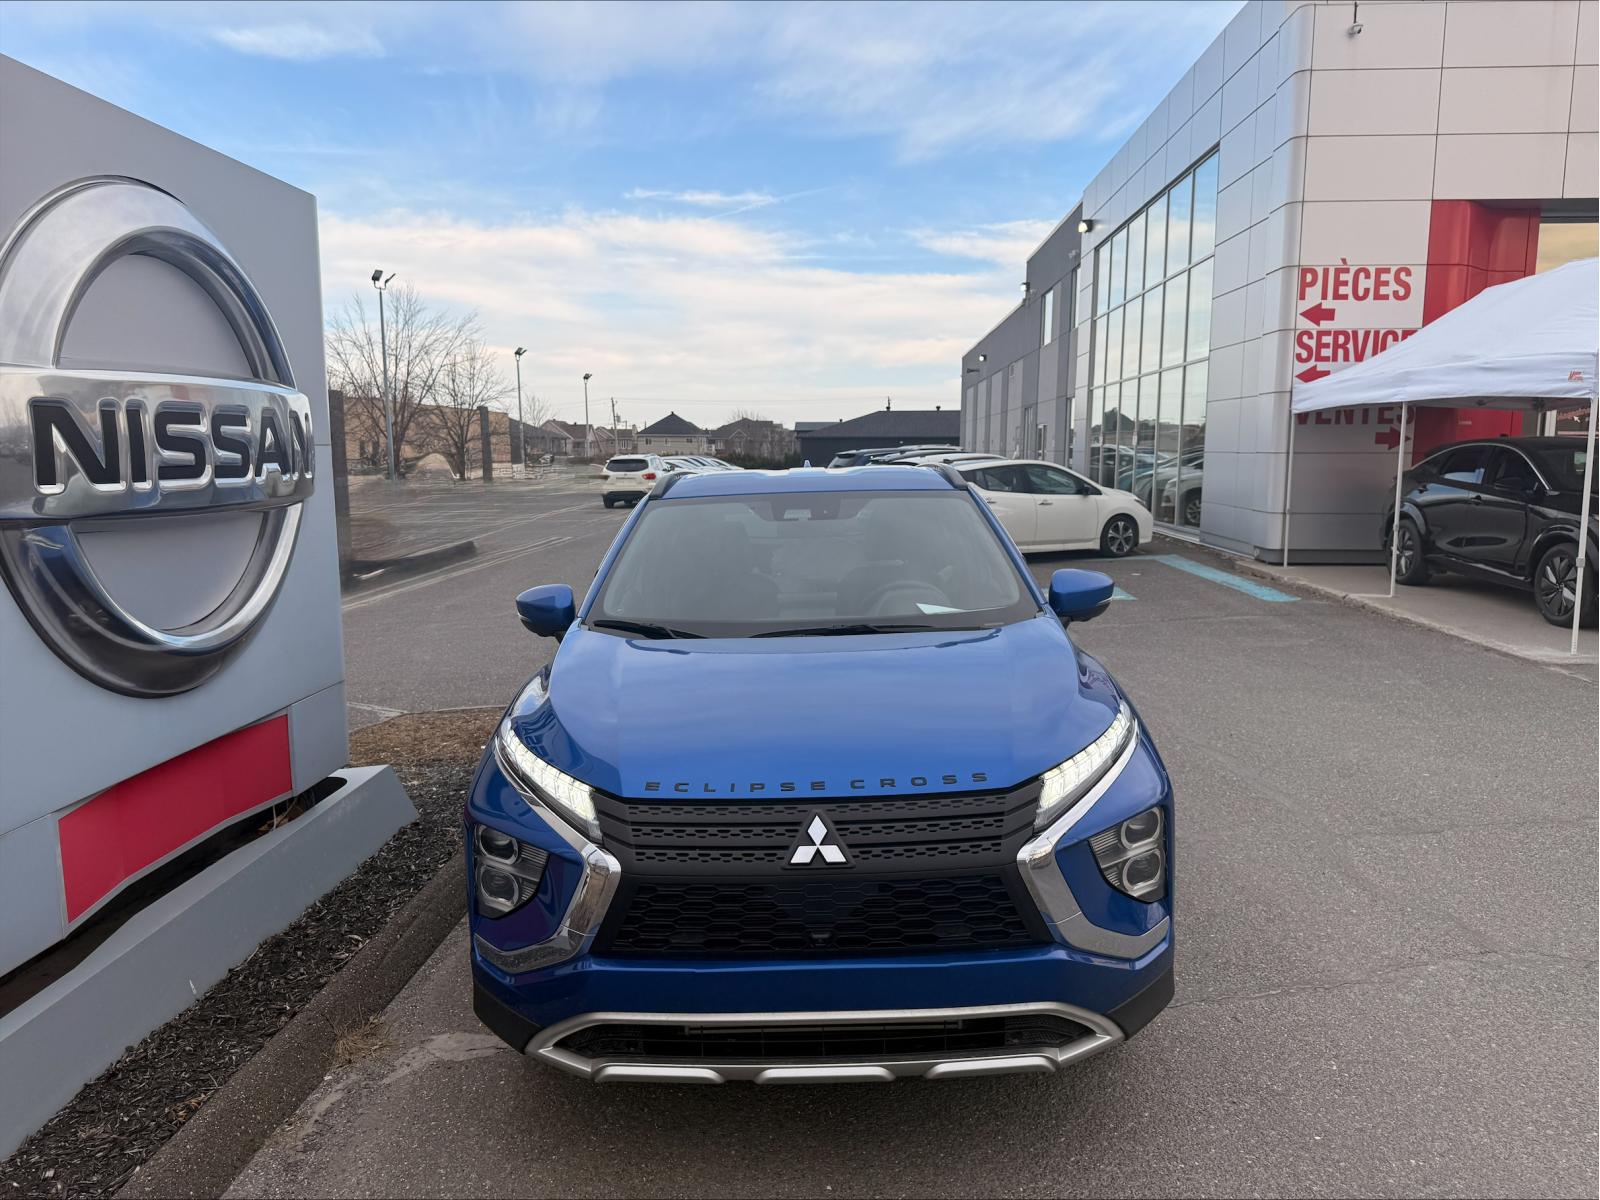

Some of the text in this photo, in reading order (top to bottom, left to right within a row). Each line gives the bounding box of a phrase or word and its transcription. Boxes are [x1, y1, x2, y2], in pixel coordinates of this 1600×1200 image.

[1298, 258, 1412, 301] PIÈCES
[1295, 330, 1418, 363] SERVIC
[28, 397, 313, 494] NISSAN
[644, 772, 988, 793] ECLIPSE CROSS
